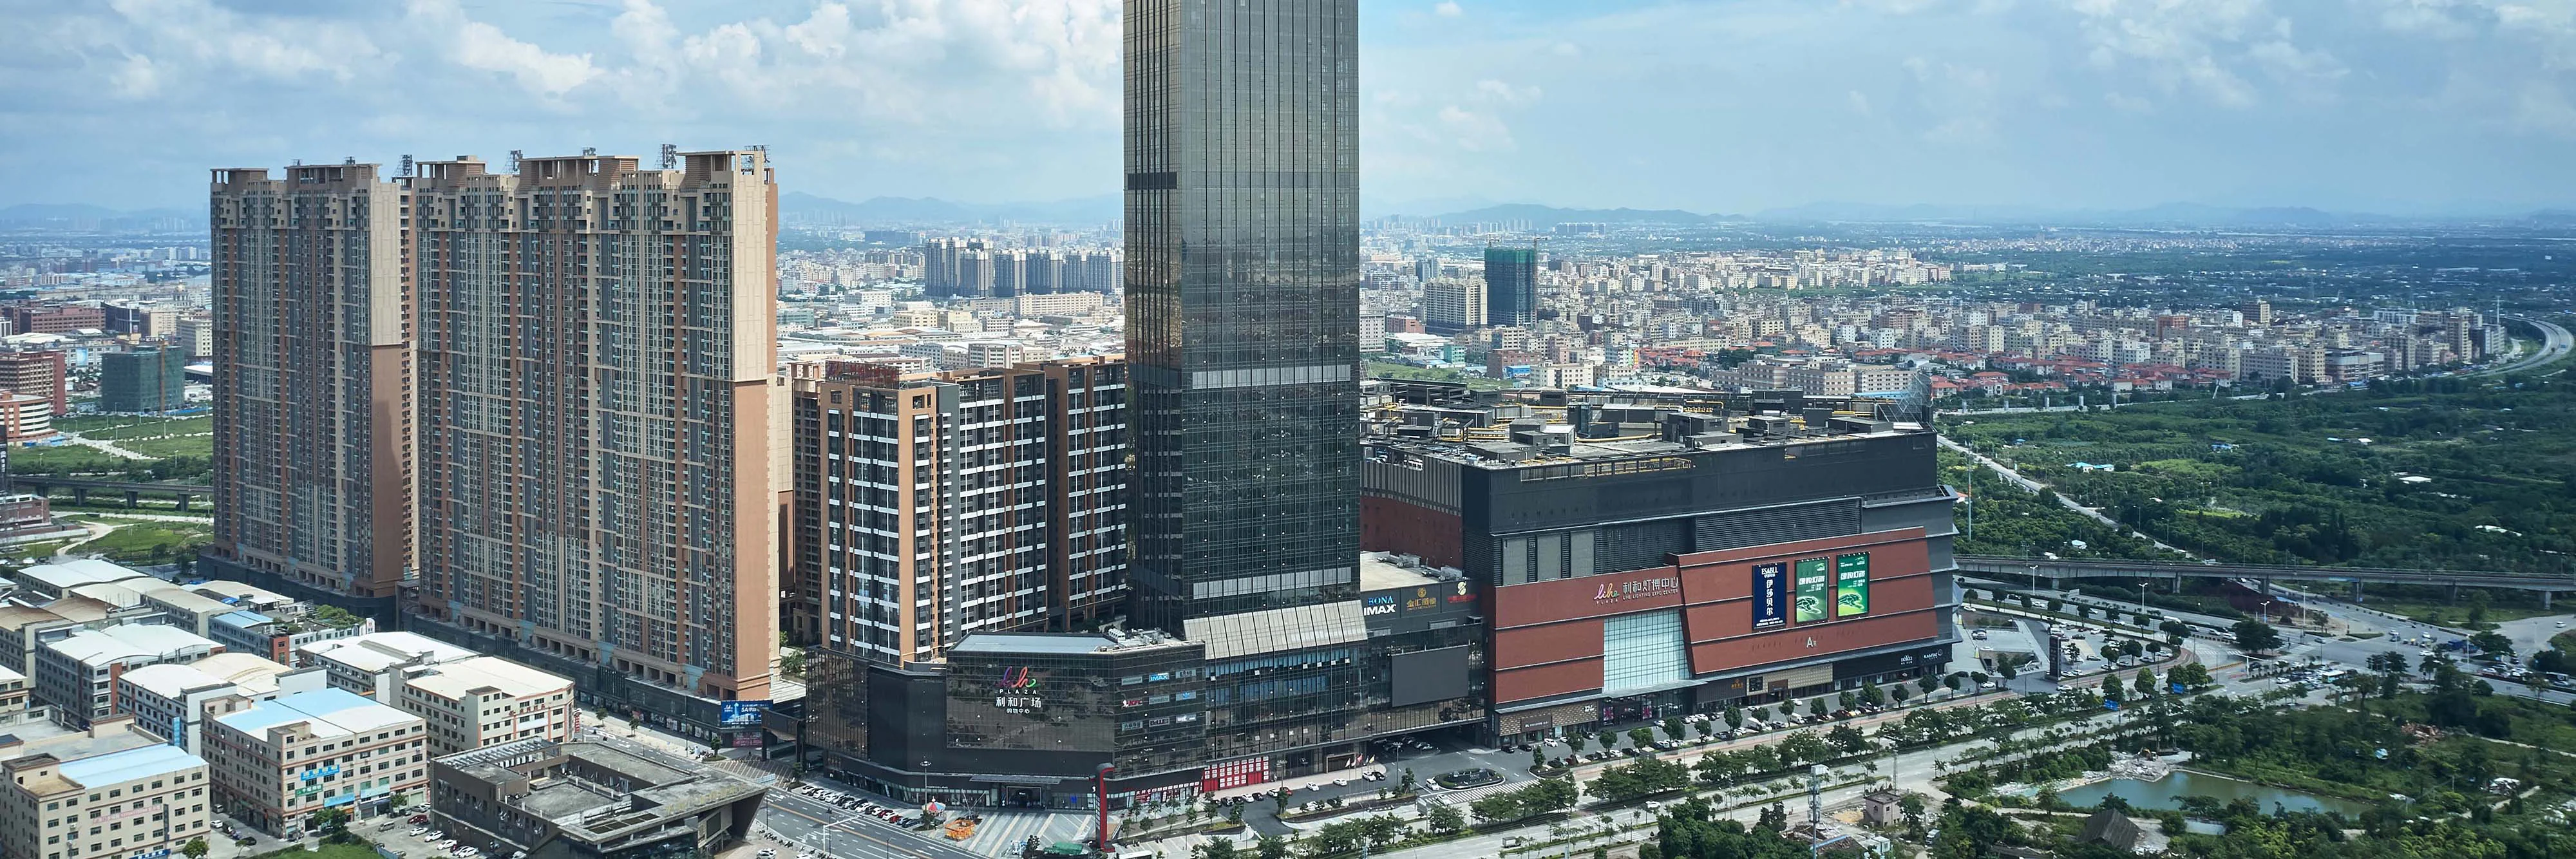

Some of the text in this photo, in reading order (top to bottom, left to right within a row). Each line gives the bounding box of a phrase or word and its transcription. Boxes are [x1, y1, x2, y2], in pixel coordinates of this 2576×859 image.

[1594, 582, 1620, 599] lihe
[1368, 596, 1394, 606] BONA
[1363, 604, 1396, 616] IMAX
[996, 697, 1041, 708] 利和广场
